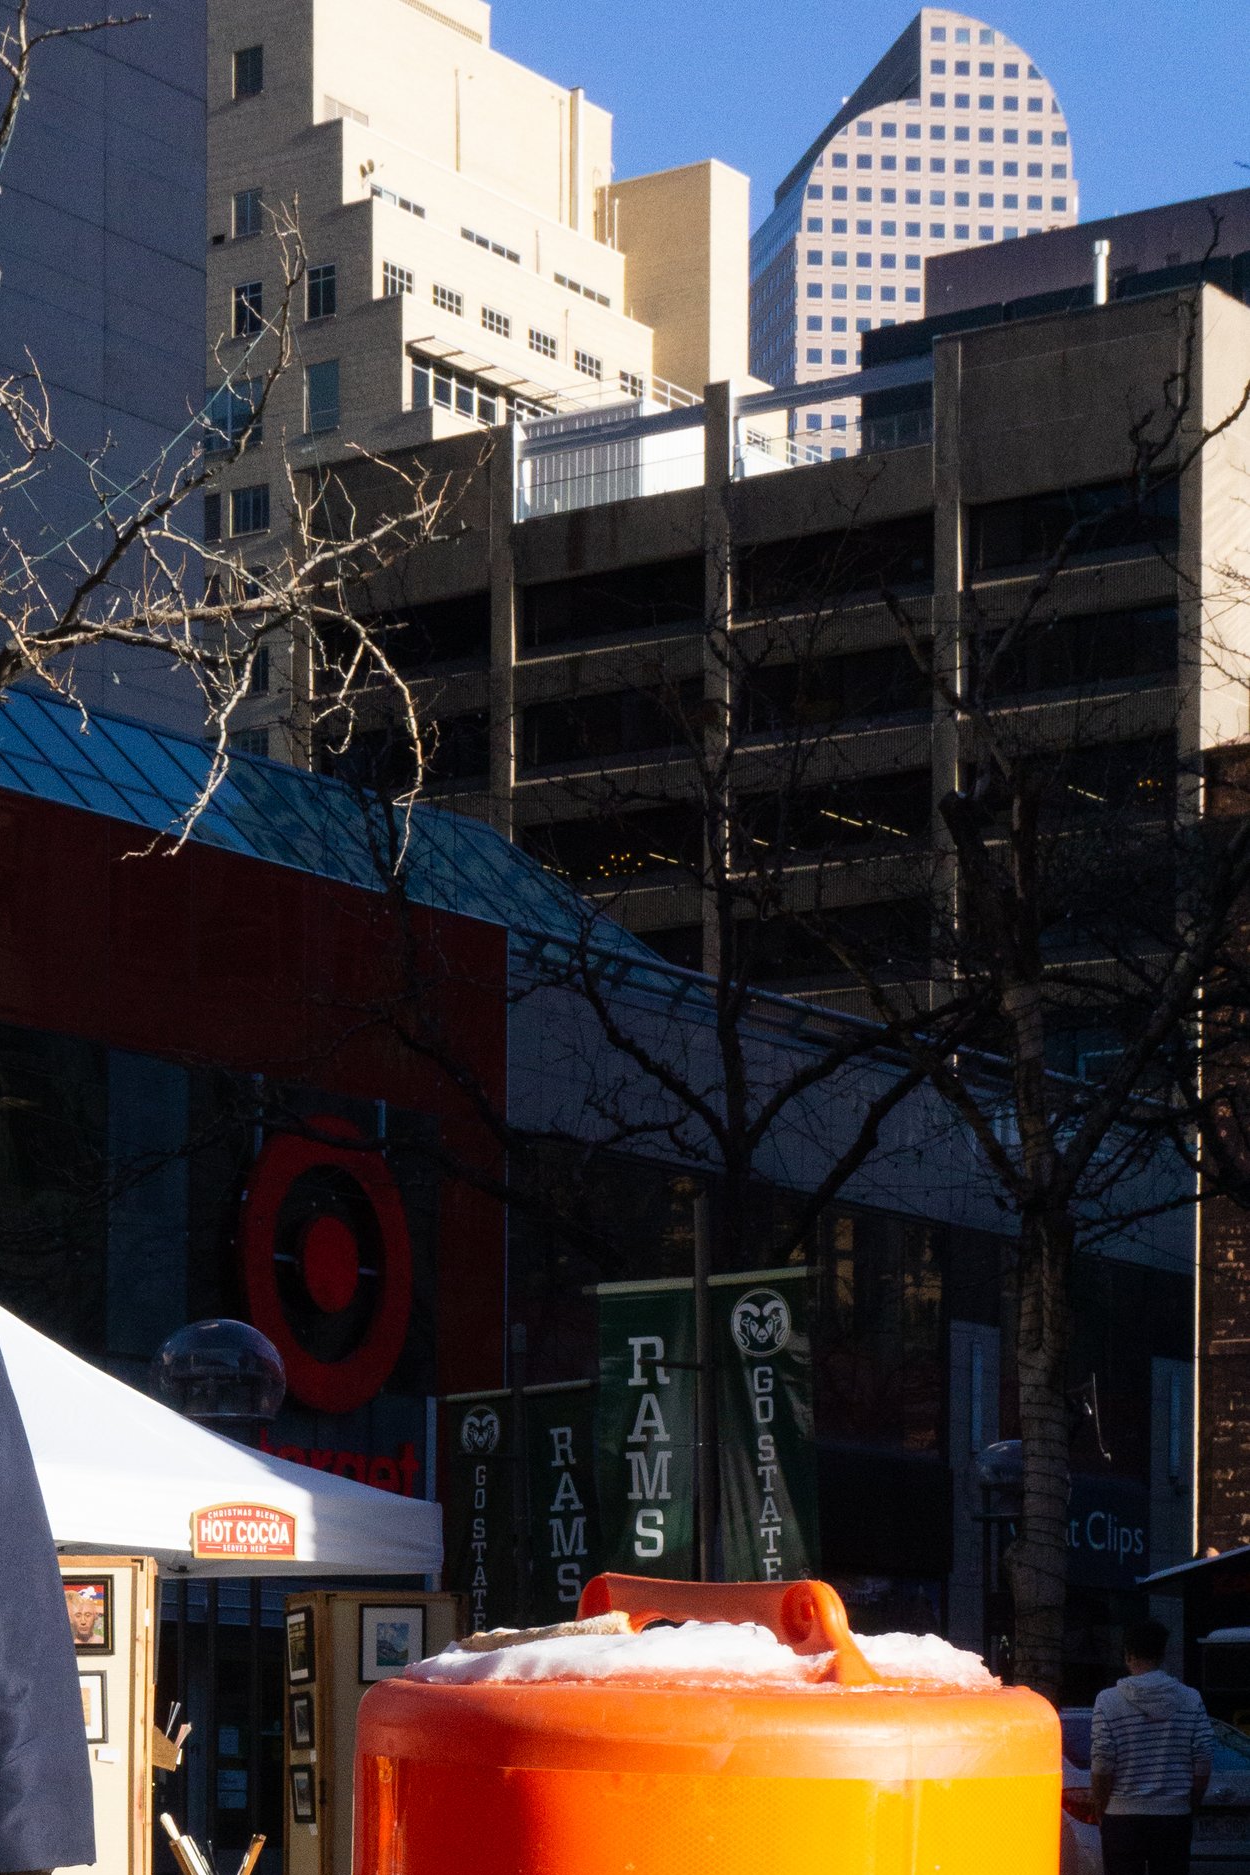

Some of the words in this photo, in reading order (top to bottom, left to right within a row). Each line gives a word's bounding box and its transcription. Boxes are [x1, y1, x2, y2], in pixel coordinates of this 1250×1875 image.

[753, 1366, 775, 1424] GO
[625, 1335, 672, 1558] RAMS
[207, 1508, 252, 1519] CHRISTMAS
[256, 1510, 281, 1522] BLEND
[474, 1465, 487, 1510] GO
[549, 1426, 588, 1603] RAMS
[757, 1434, 784, 1582] STATE
[200, 1520, 233, 1543] HOT
[236, 1521, 290, 1545] COCOA
[1086, 1510, 1144, 1565] Clips
[470, 1517, 487, 1633] STATE
